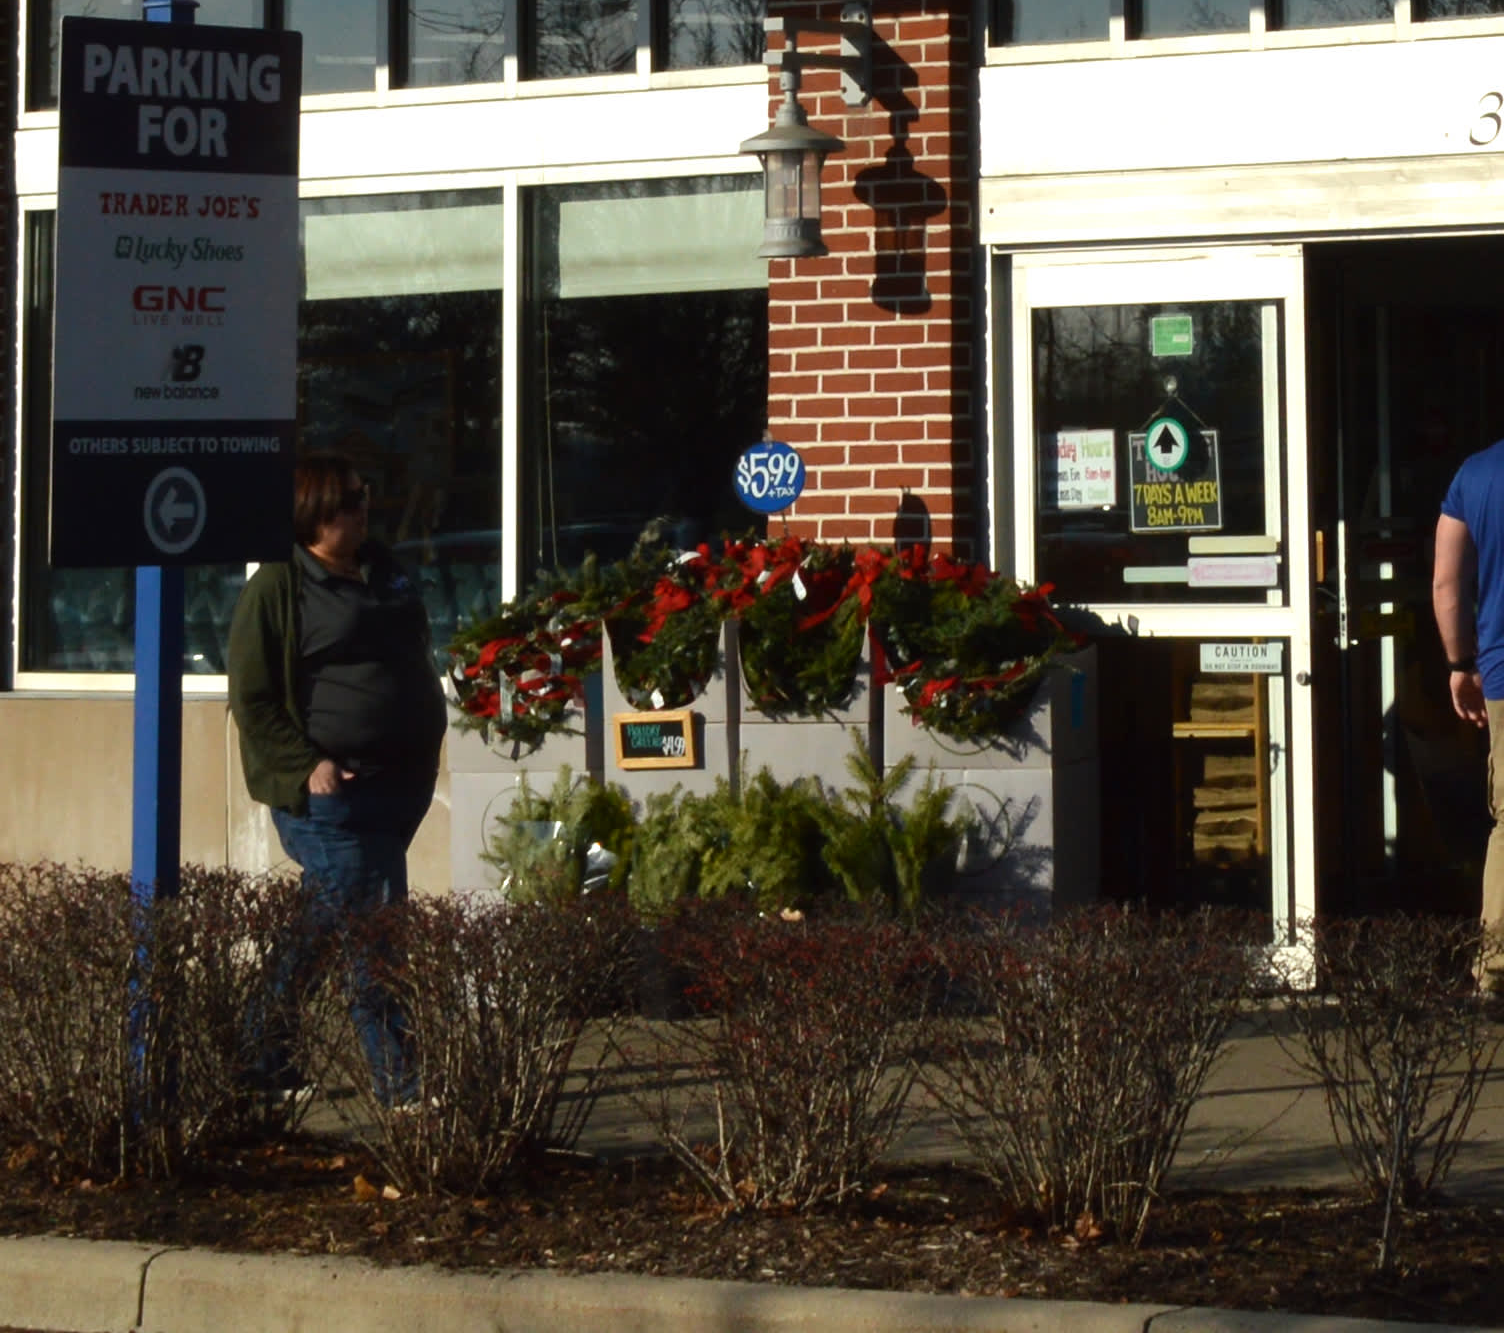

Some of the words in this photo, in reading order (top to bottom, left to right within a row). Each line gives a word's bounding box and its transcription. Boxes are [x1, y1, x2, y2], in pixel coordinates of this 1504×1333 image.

[83, 44, 281, 103] PARKING
[137, 104, 228, 158] FOR
[99, 192, 189, 217] TRADER
[198, 194, 261, 219] JOE'S
[135, 235, 188, 269] Lucky
[190, 236, 244, 262] Shoes
[132, 285, 226, 313] GNC
[133, 314, 169, 326] LIVE
[134, 386, 161, 400] new
[163, 384, 219, 400] balance
[69, 437, 129, 454] OTHERS
[132, 437, 196, 454] SUBJECT
[198, 437, 218, 454] TO
[220, 436, 280, 453] TOWING
[738, 452, 800, 498] $5.99
[1185, 481, 1218, 504] WEEK
[1147, 506, 1204, 526] 8AM-9PM
[1215, 646, 1267, 658] CAUTION
